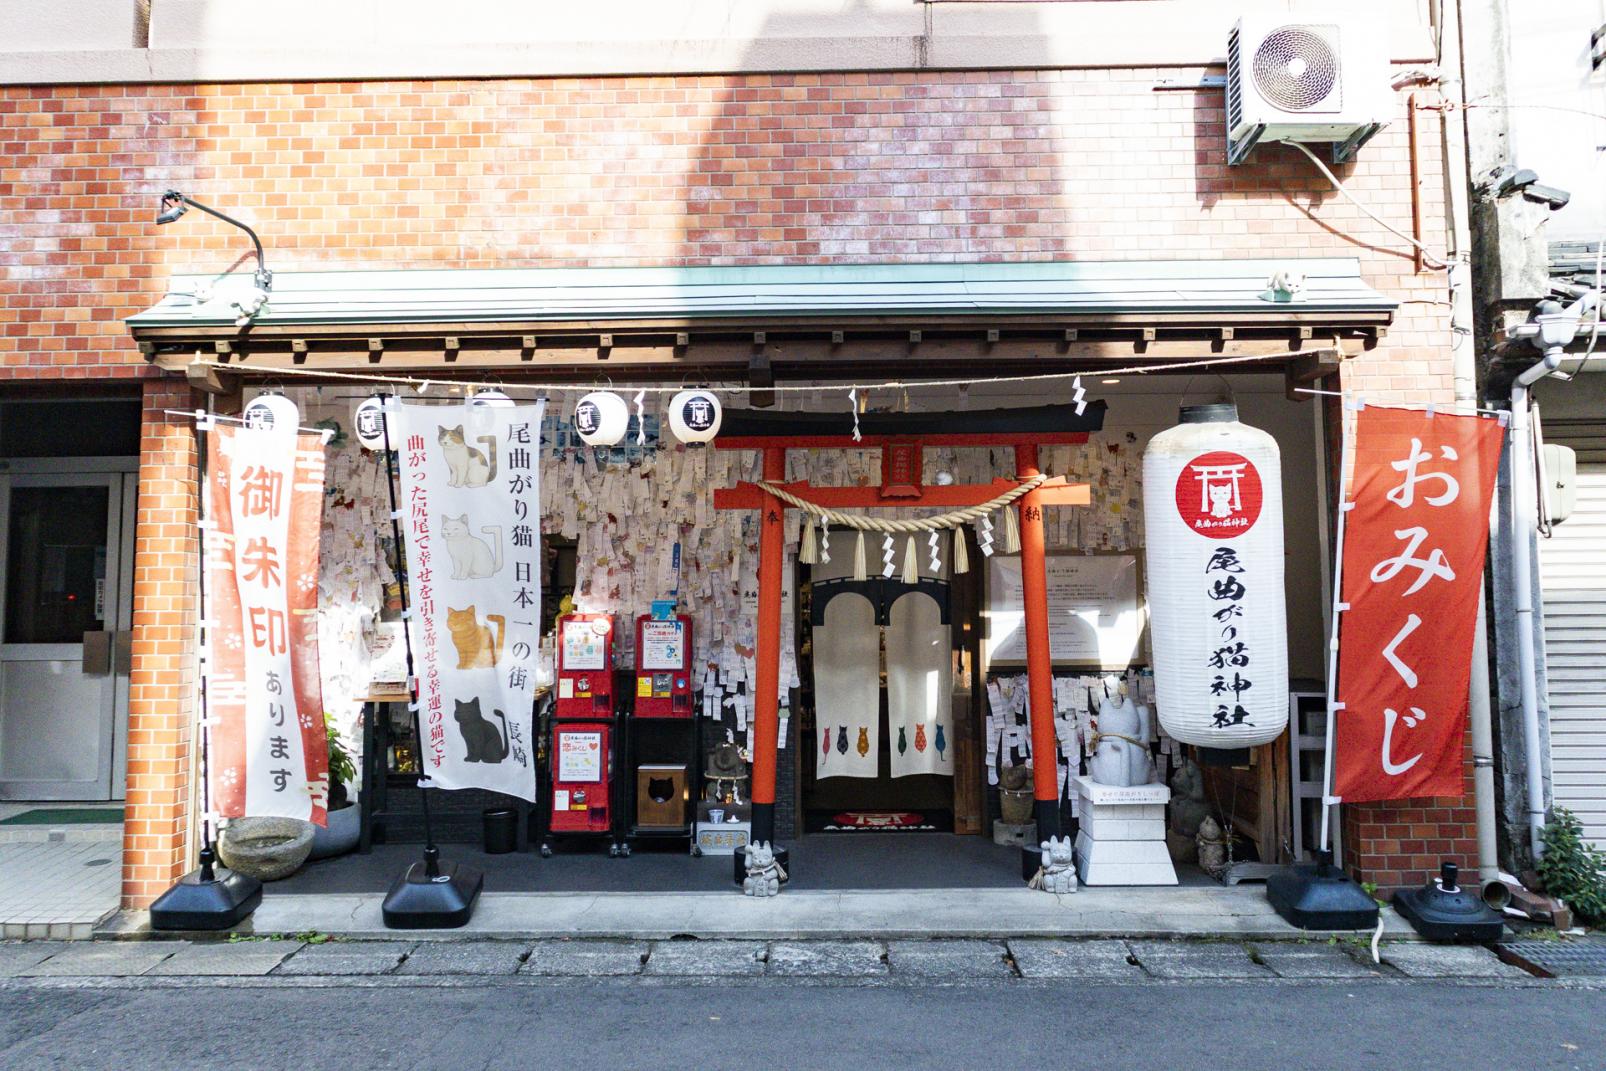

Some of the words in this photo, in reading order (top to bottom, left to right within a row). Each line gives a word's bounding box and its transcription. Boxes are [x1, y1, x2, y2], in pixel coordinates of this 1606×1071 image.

[508, 422, 533, 548] 尾曲がり猫
[767, 510, 780, 527] 奉
[1025, 506, 1041, 522] 納
[1195, 517, 1249, 529] 尾曲がり猫神社
[239, 465, 293, 793] 御朱印あります
[407, 434, 446, 768] 曲がった尻尾で幸せを引き寄せる幸運の猫です
[509, 562, 534, 690] 日本一の街
[1206, 547, 1256, 729] 尾曲がり猫神社
[1370, 438, 1460, 776] おみくじ
[508, 720, 528, 768] 長崎
